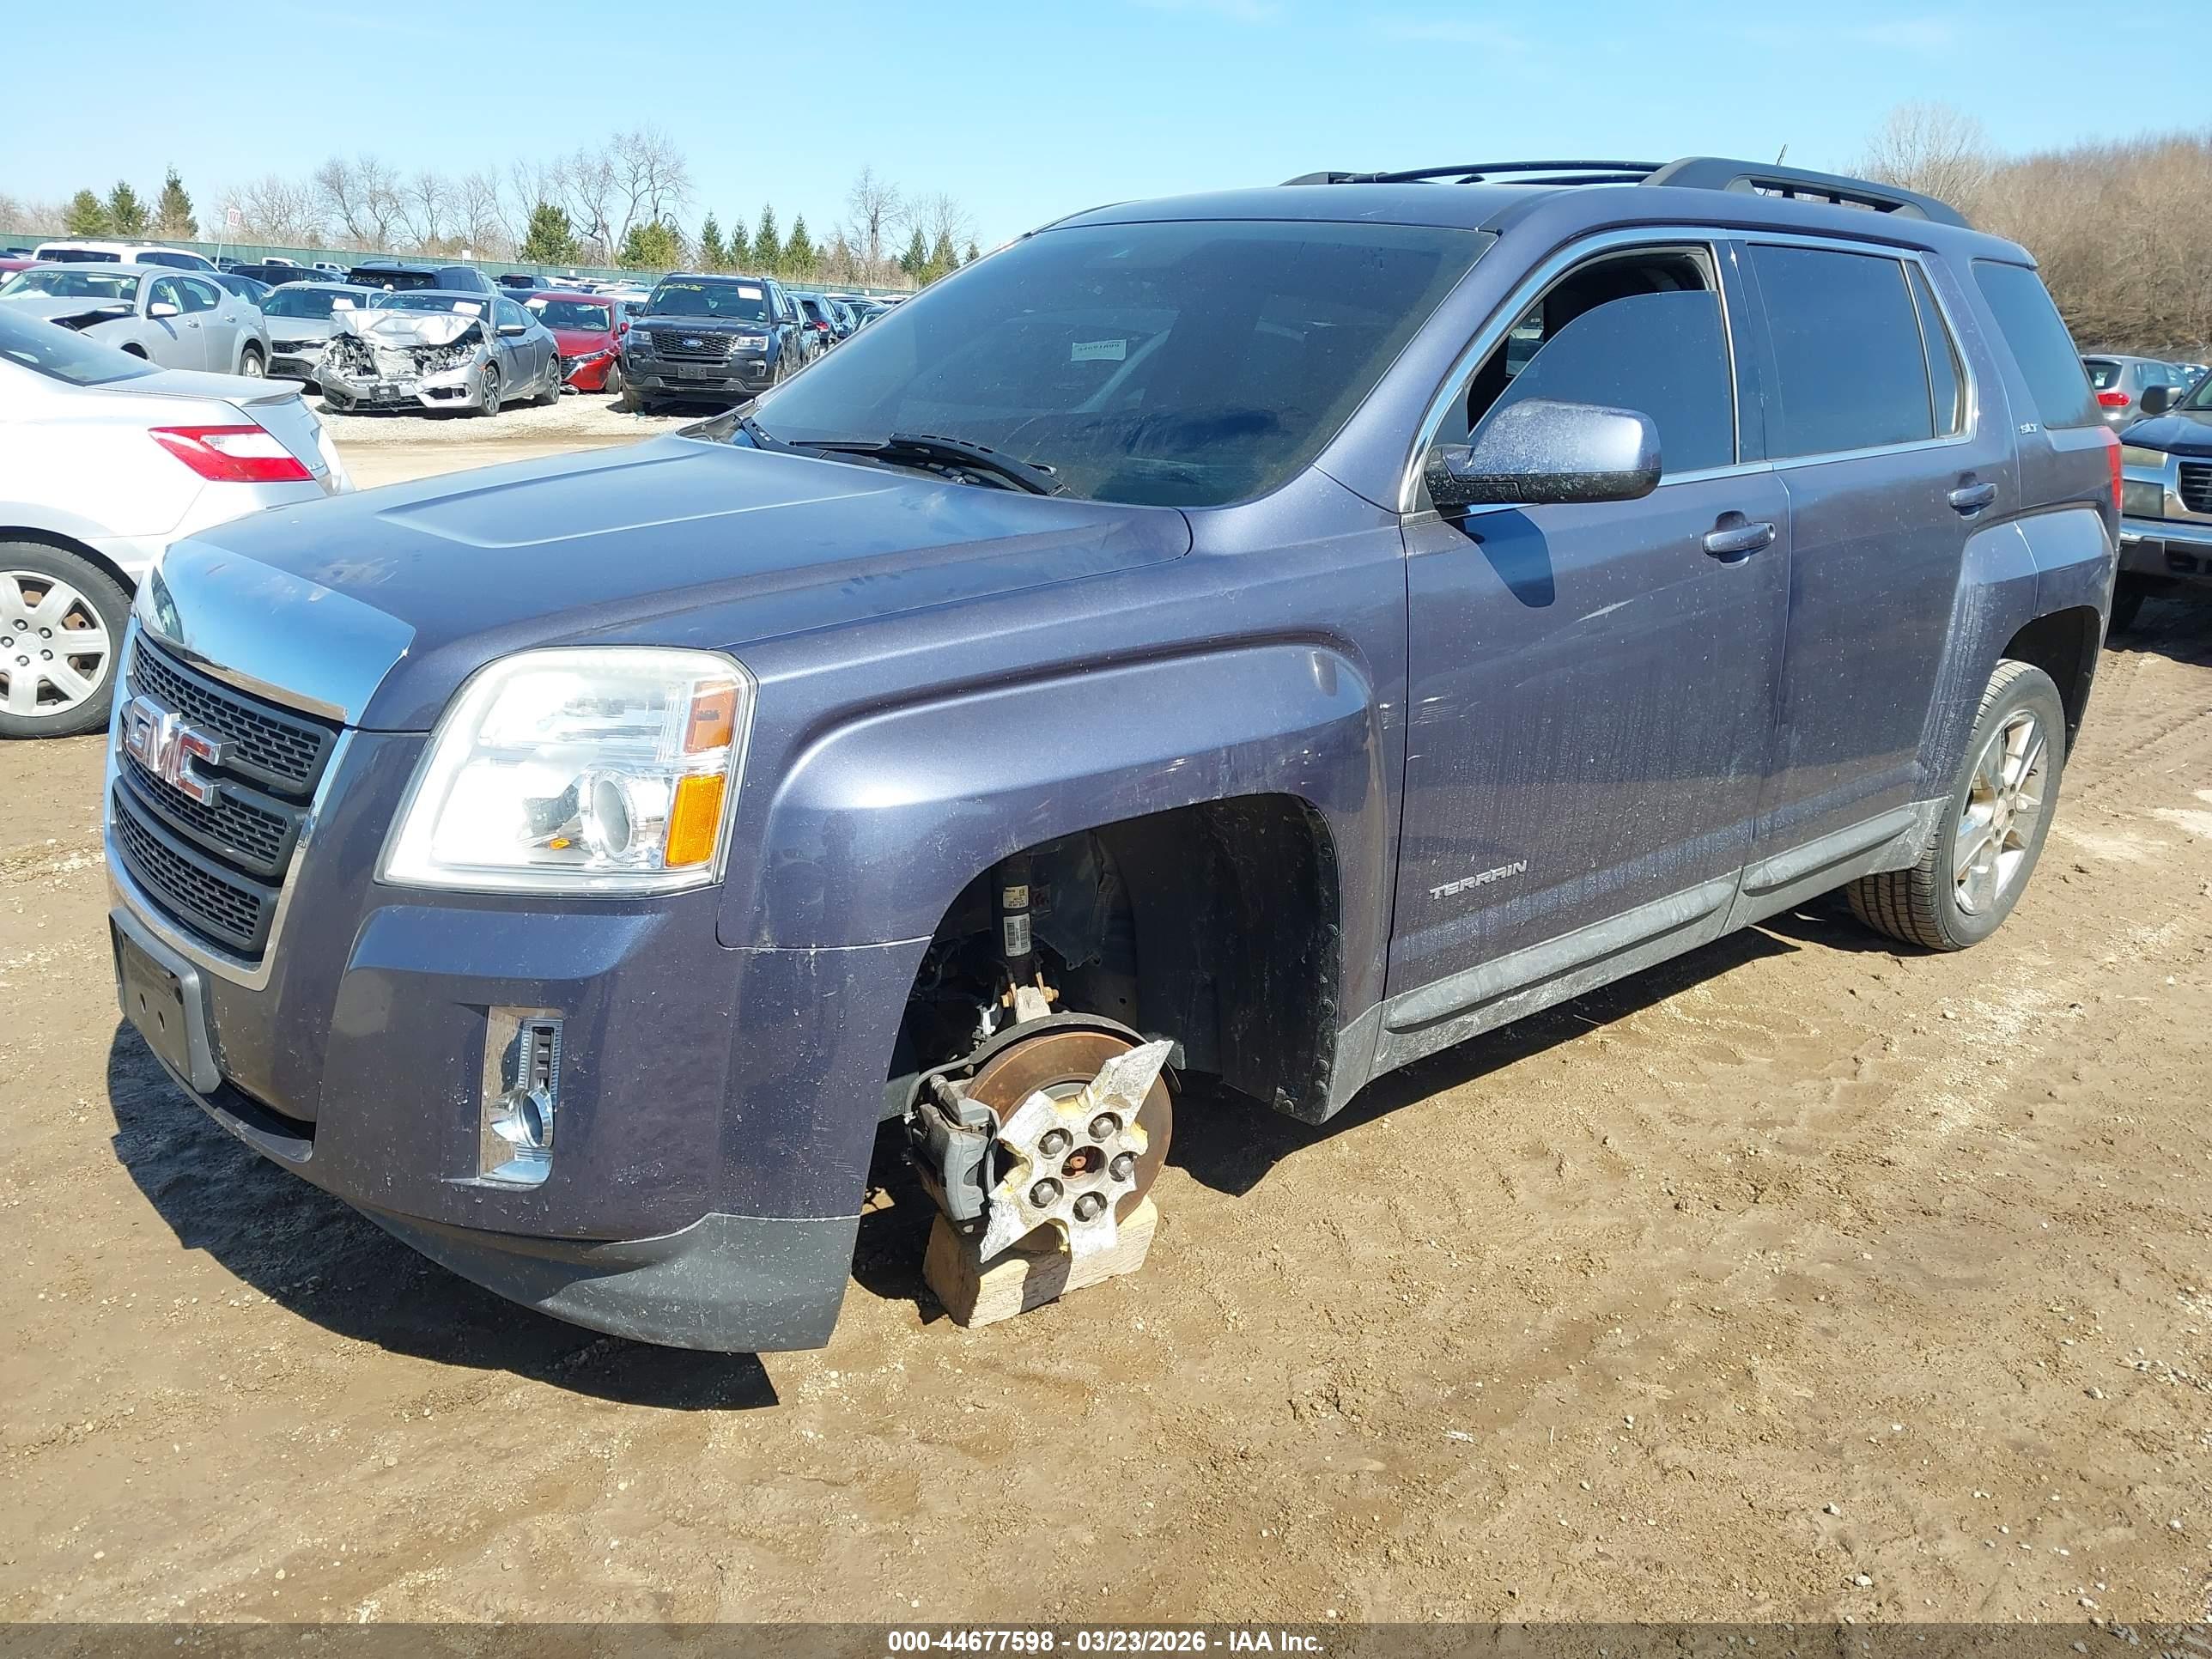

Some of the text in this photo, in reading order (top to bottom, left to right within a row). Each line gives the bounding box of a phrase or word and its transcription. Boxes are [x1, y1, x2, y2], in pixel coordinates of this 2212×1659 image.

[2020, 422, 2039, 434] SLT
[126, 695, 221, 806] GMC
[1429, 859, 1528, 901] TERRAIN
